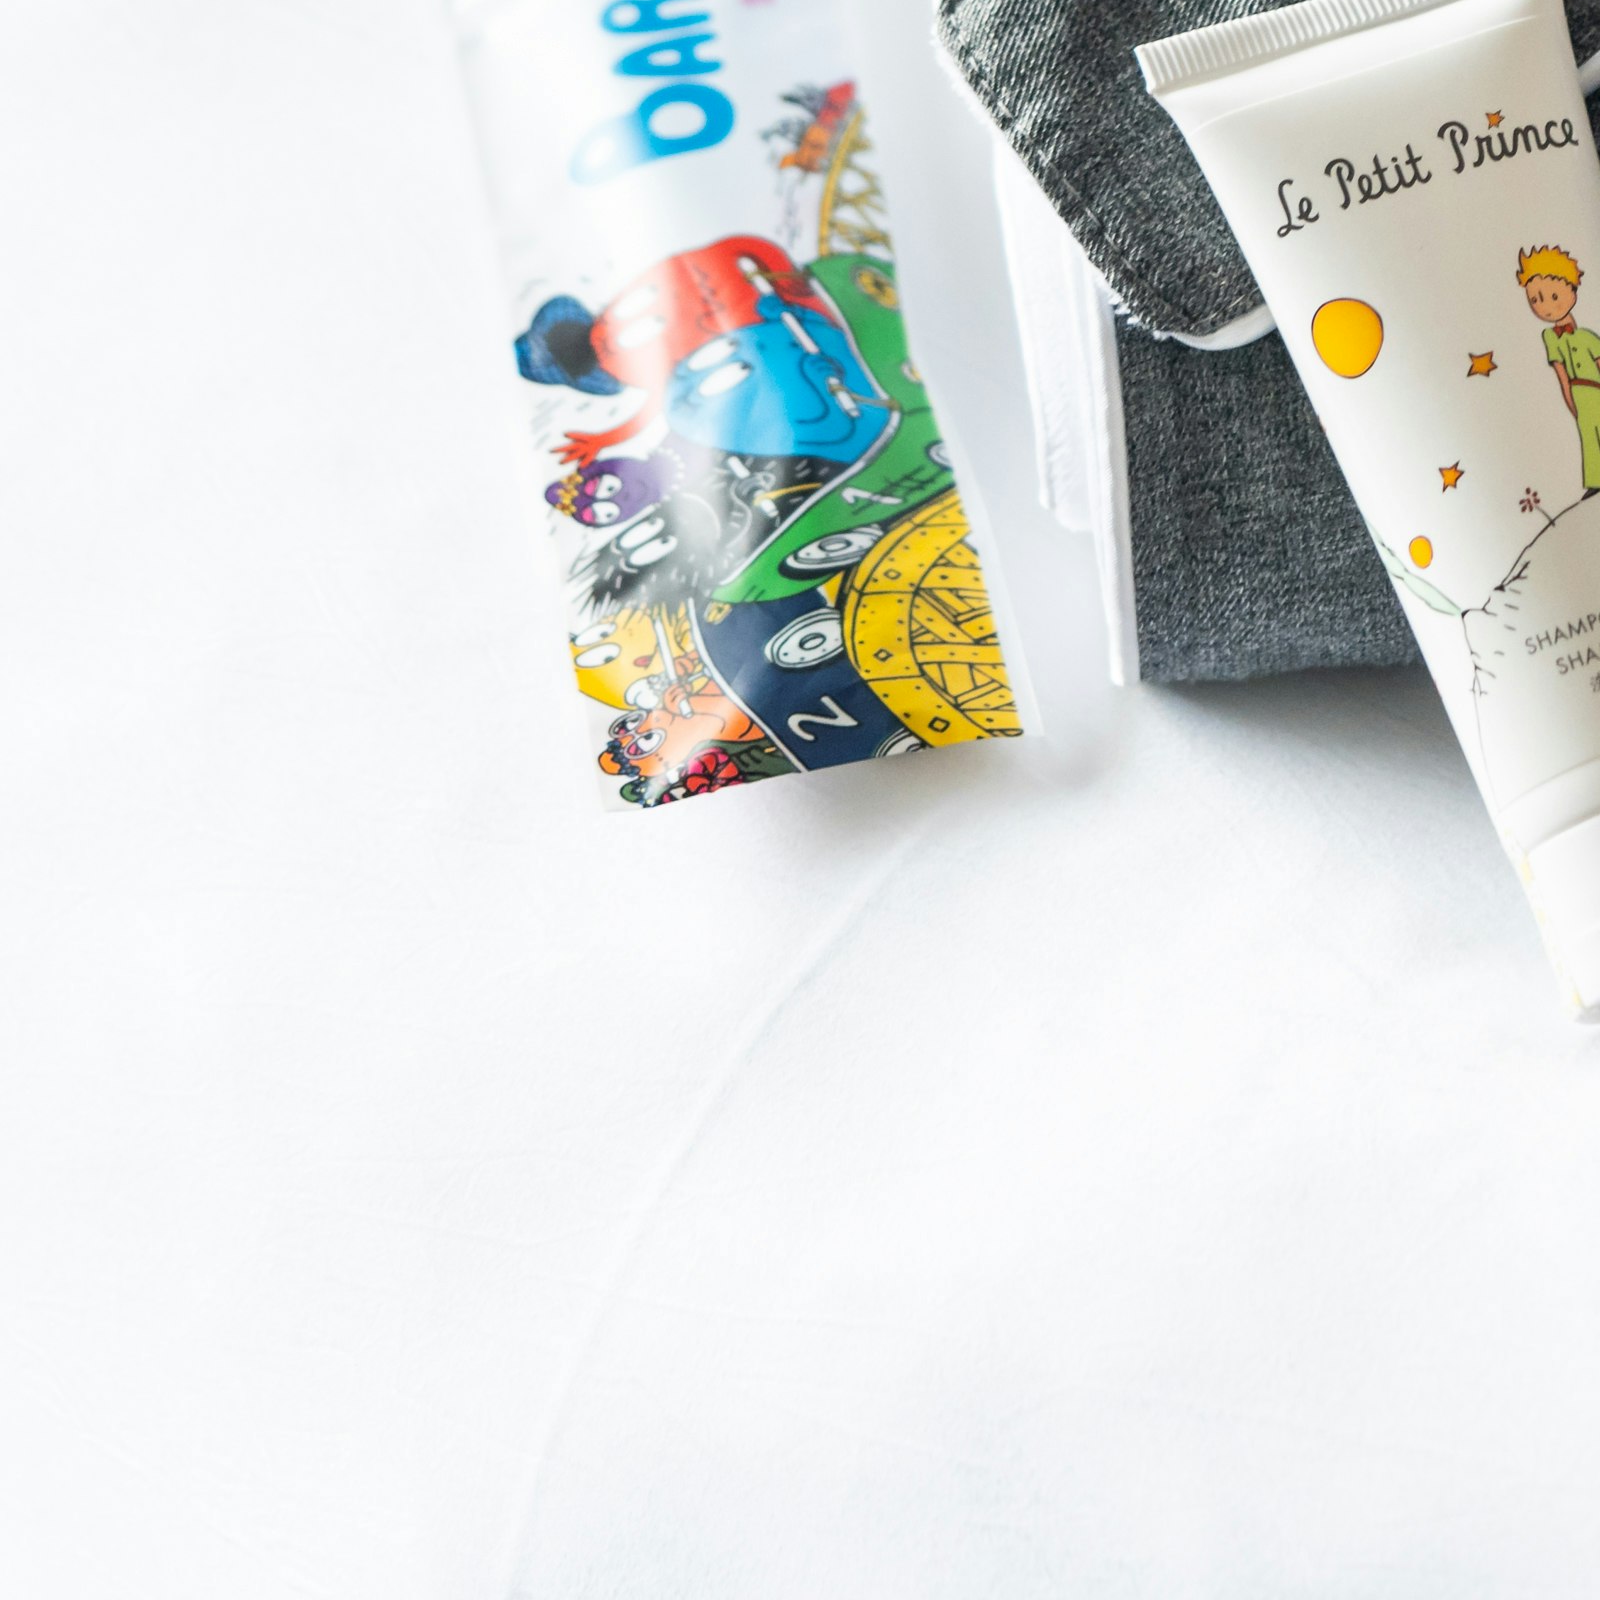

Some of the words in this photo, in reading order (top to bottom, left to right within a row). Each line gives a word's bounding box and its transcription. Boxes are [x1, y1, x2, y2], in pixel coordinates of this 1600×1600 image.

[1276, 178, 1320, 239] Le
[1323, 143, 1433, 211] Petit
[1436, 112, 1580, 174] Prince
